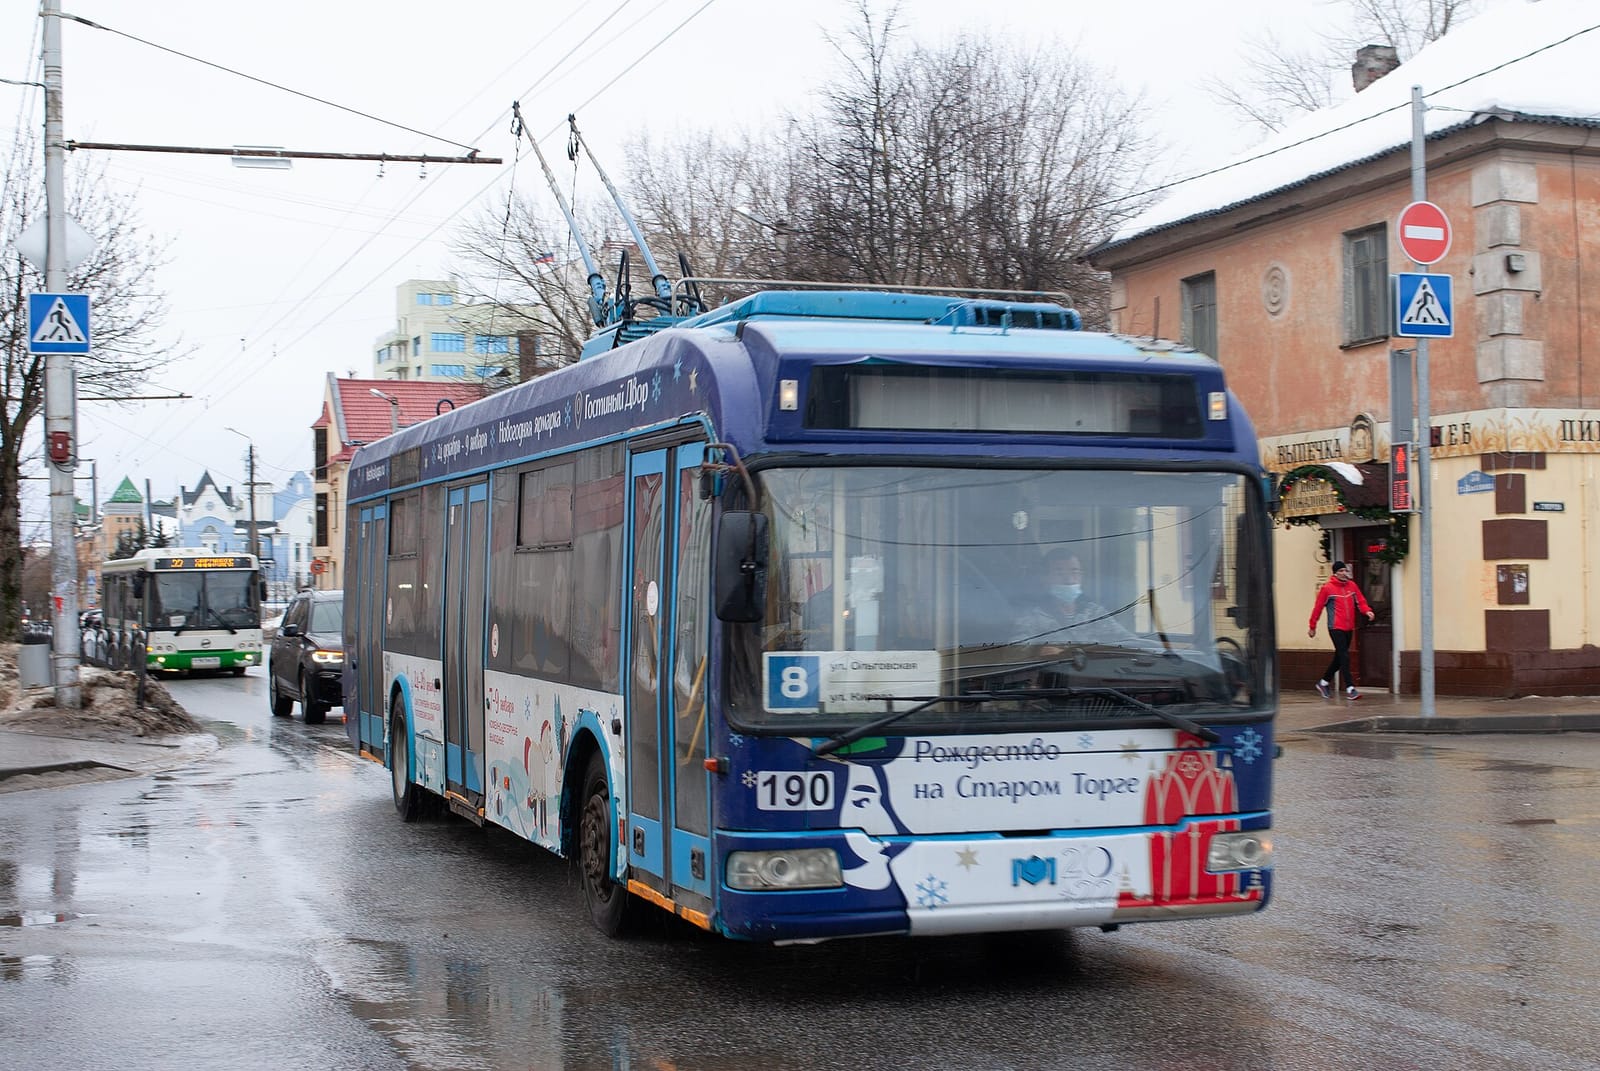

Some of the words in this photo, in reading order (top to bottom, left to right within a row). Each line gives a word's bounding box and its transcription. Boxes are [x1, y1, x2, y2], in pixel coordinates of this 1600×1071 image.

[584, 385, 625, 420] Гостиный
[498, 418, 533, 447] Новогодняя
[534, 410, 561, 440] ярмарка
[1560, 419, 1600, 441] ПИ
[1277, 438, 1344, 465] ВЫПЕЧКА
[780, 666, 809, 699] 8
[829, 663, 847, 673] ул.
[913, 737, 1061, 769] Рождество
[762, 773, 829, 807] 190
[913, 783, 944, 800] на
[956, 774, 1061, 803] Старом
[1072, 772, 1140, 801] Торге
